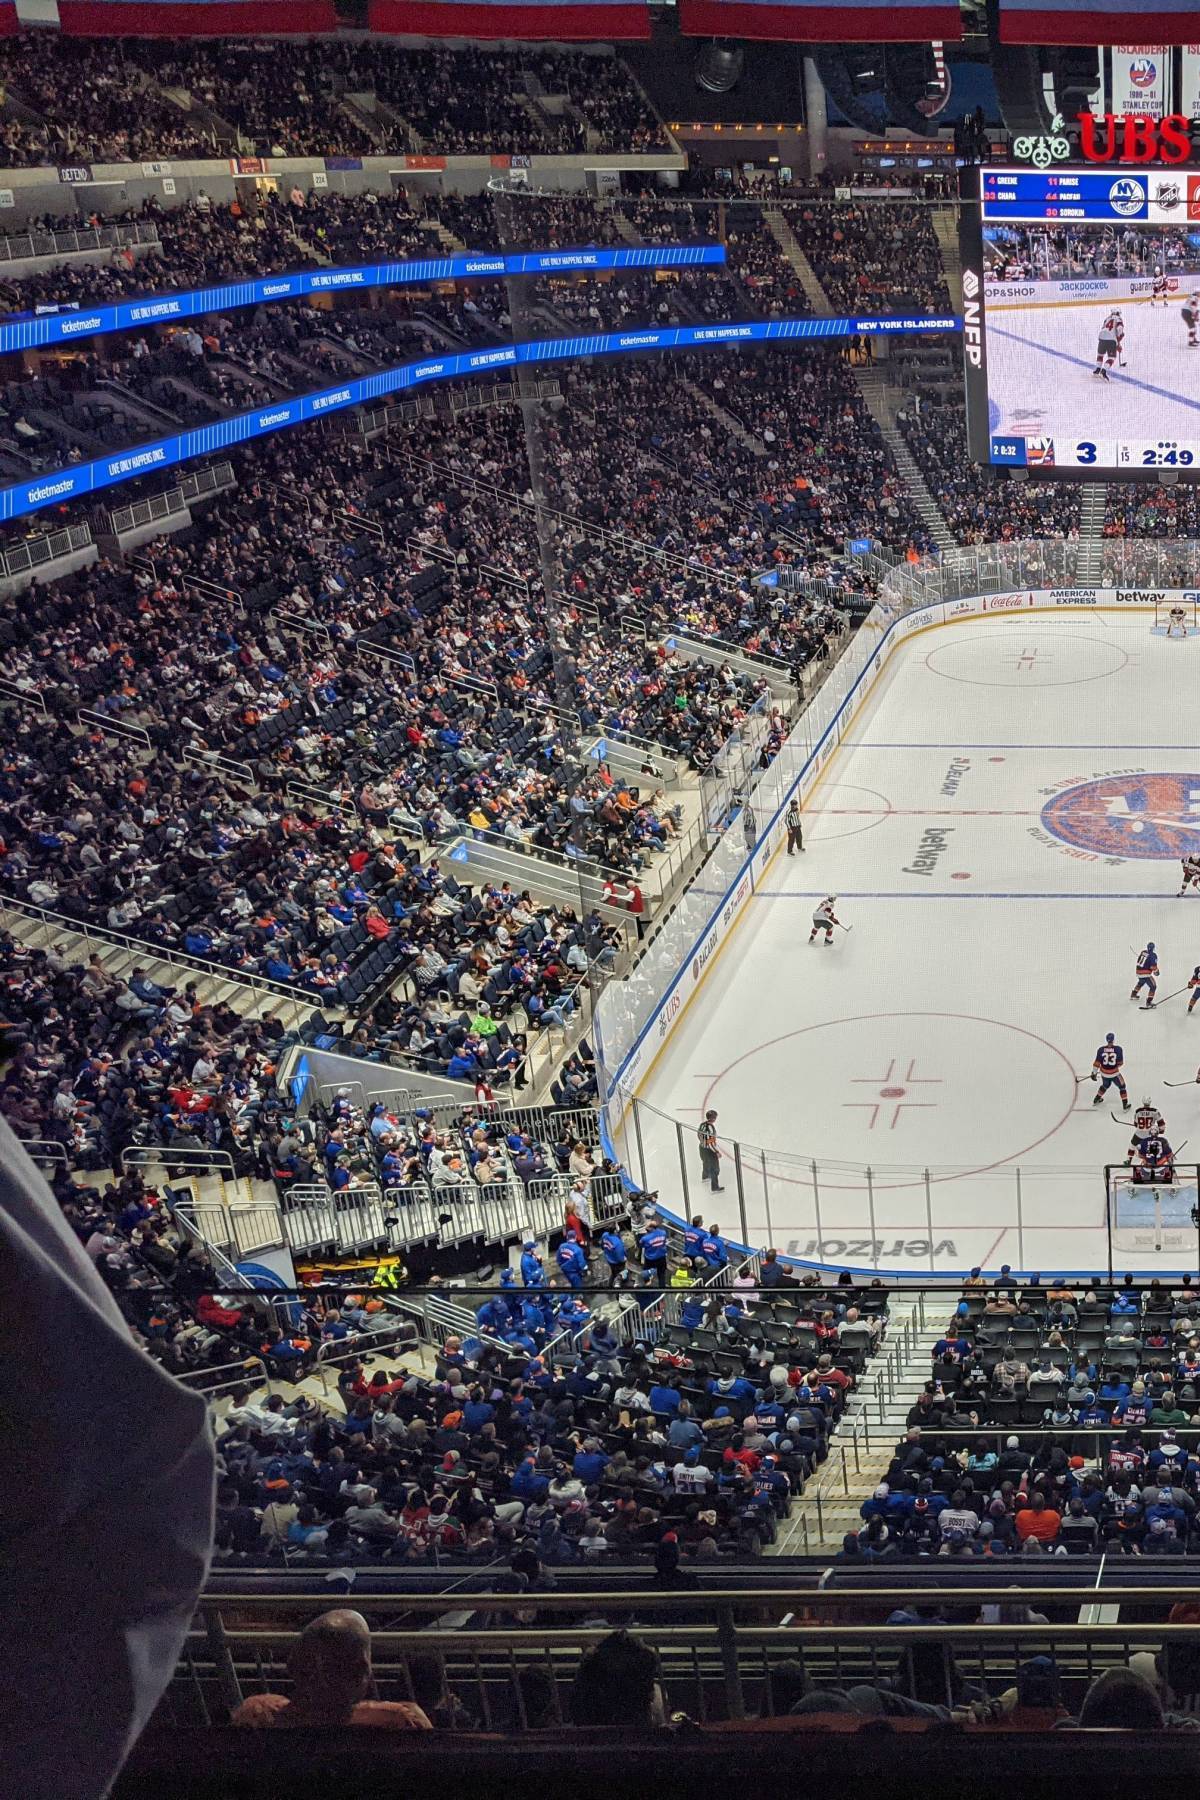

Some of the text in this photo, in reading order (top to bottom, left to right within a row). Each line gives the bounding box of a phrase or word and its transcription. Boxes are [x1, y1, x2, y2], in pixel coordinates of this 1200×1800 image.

[1122, 101, 1164, 109] STANLEY CUP
[1077, 113, 1190, 163] UBS
[466, 262, 505, 272] ticketmaste
[61, 317, 101, 334] ticketmaster
[857, 320, 955, 330] NEW YORK ISLANDERS
[620, 335, 660, 346] ticketmaster
[962, 301, 982, 368] NFP
[1000, 446, 1017, 456] 0:32
[1076, 442, 1097, 464] 3
[1121, 451, 1130, 462] 15
[1142, 450, 1194, 466] 2:49
[27, 479, 74, 503] ticketmaster
[1049, 590, 1096, 598] AMERICAN
[1115, 591, 1166, 603] betway
[1056, 597, 1097, 605] EXPRESS
[901, 828, 956, 876] betway
[665, 989, 681, 1023] UBS
[1101, 1053, 1117, 1066] 33
[1137, 1116, 1154, 1130] 90
[786, 1239, 958, 1262] verizon
